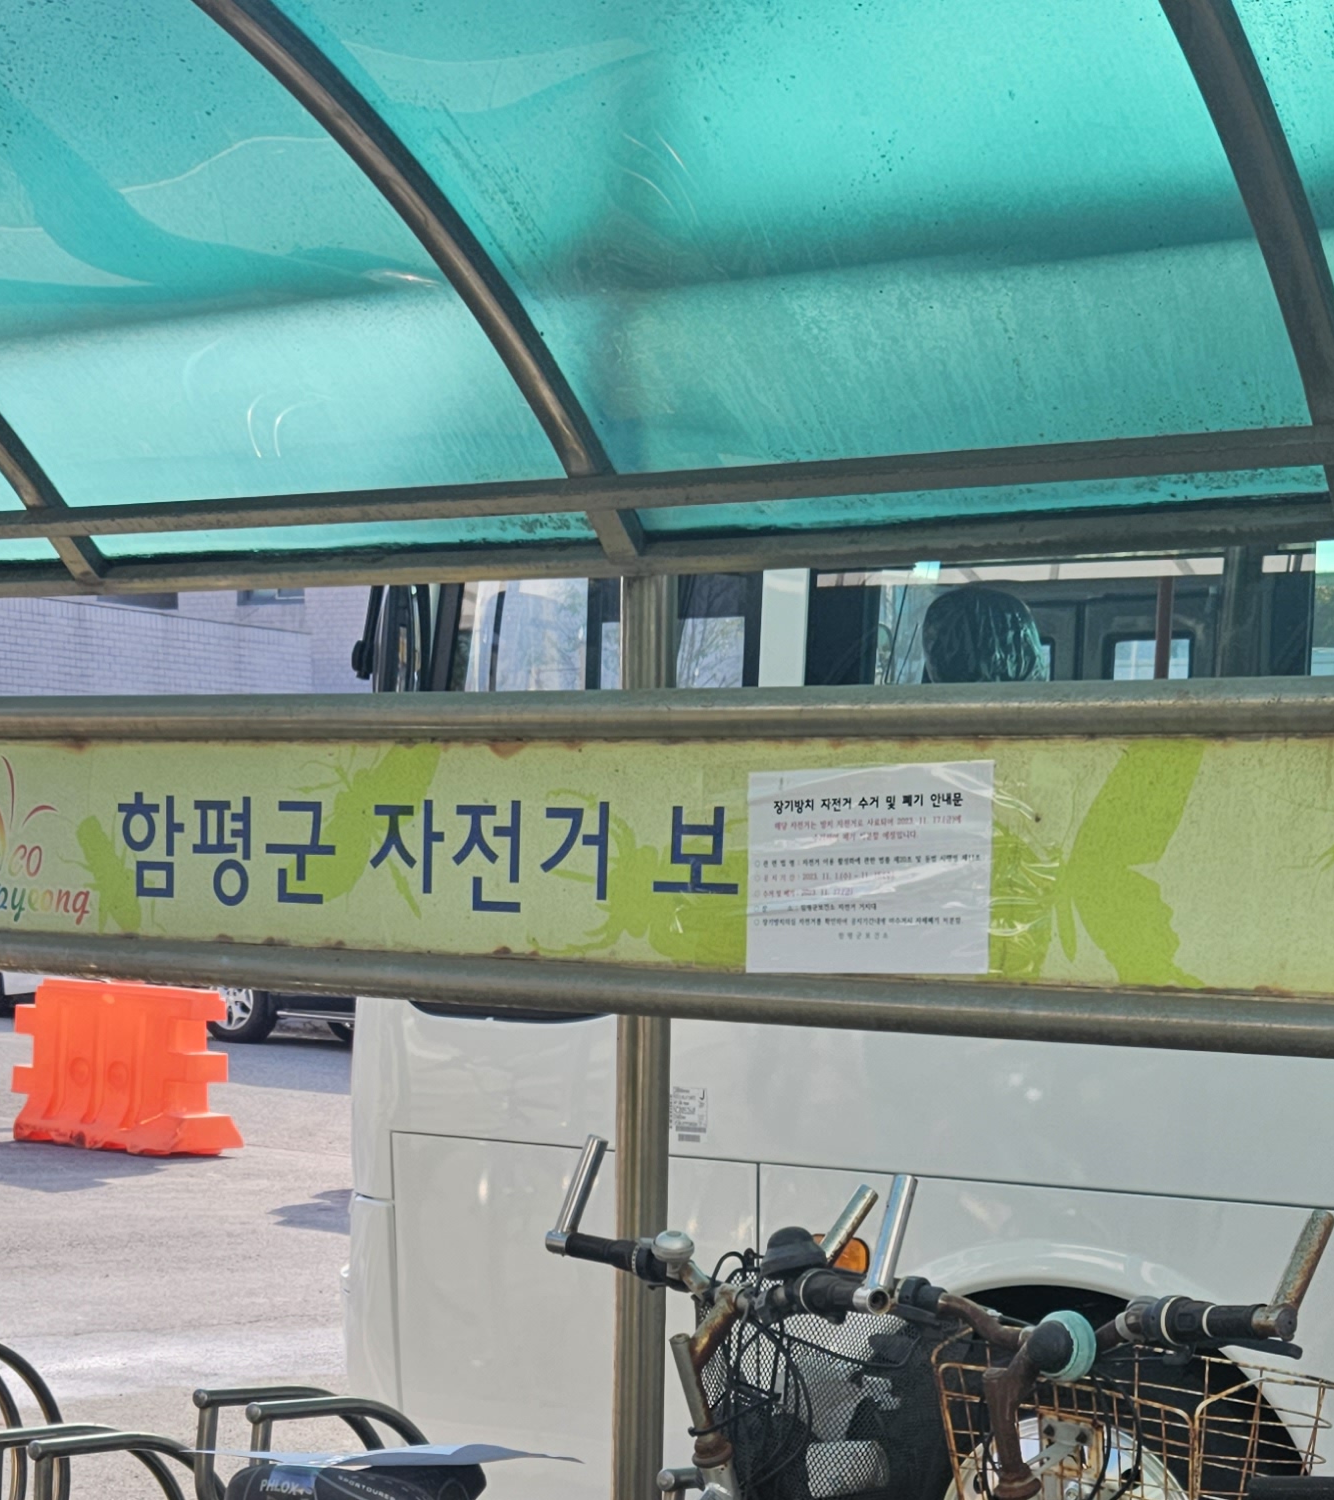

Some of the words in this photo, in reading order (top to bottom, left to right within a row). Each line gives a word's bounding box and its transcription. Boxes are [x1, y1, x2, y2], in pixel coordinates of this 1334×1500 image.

[773, 799, 815, 815] 장기방치
[820, 797, 852, 812] 자전거
[858, 796, 879, 810] 수거
[886, 795, 896, 810] 및
[902, 794, 924, 807] 폐기
[930, 792, 964, 807] 안내문
[117, 790, 337, 908] 함평군
[369, 799, 610, 915] 자전거
[652, 804, 739, 896] 보
[259, 1479, 300, 1496] PHLOX
